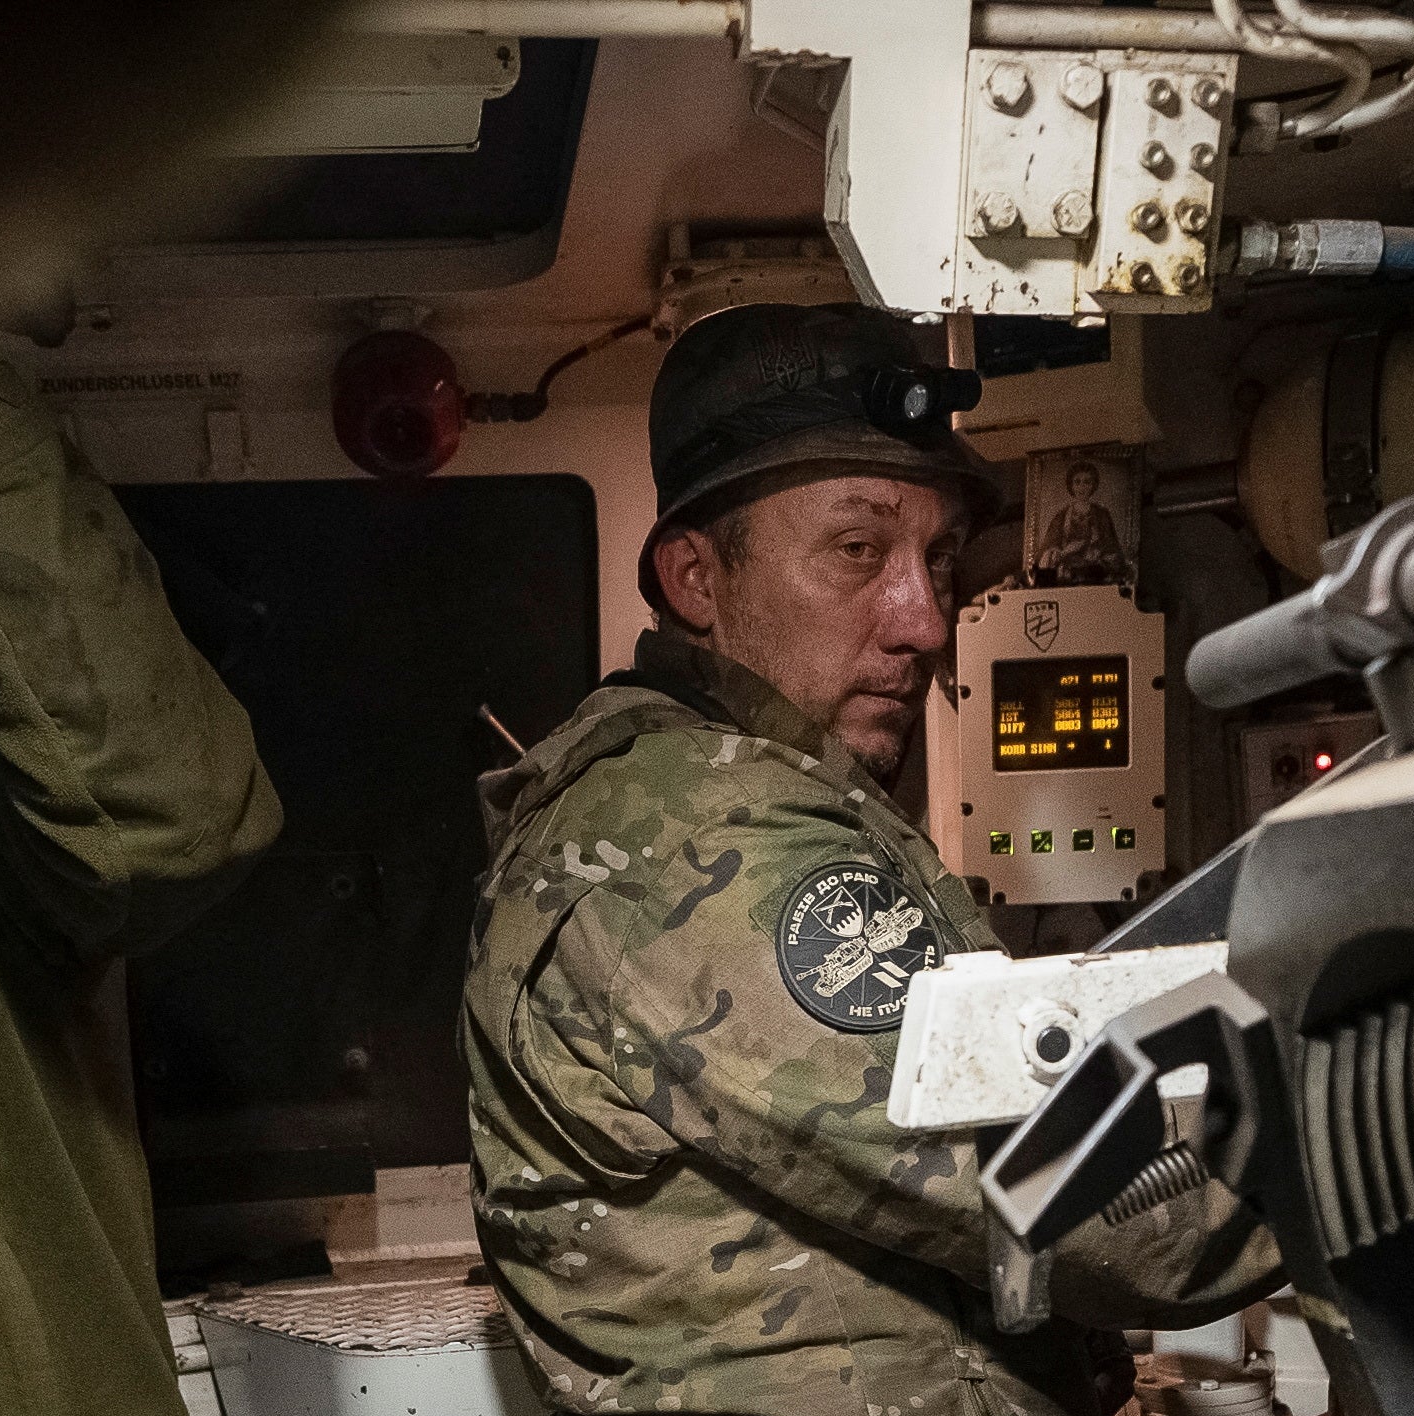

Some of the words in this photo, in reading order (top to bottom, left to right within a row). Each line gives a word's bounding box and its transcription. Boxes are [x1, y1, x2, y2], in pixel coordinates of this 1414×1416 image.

[1000, 721, 1026, 734] DIFF
[815, 875, 840, 896] ДО
[842, 872, 879, 885] РАЮ
[849, 1004, 873, 1017] НЕ
